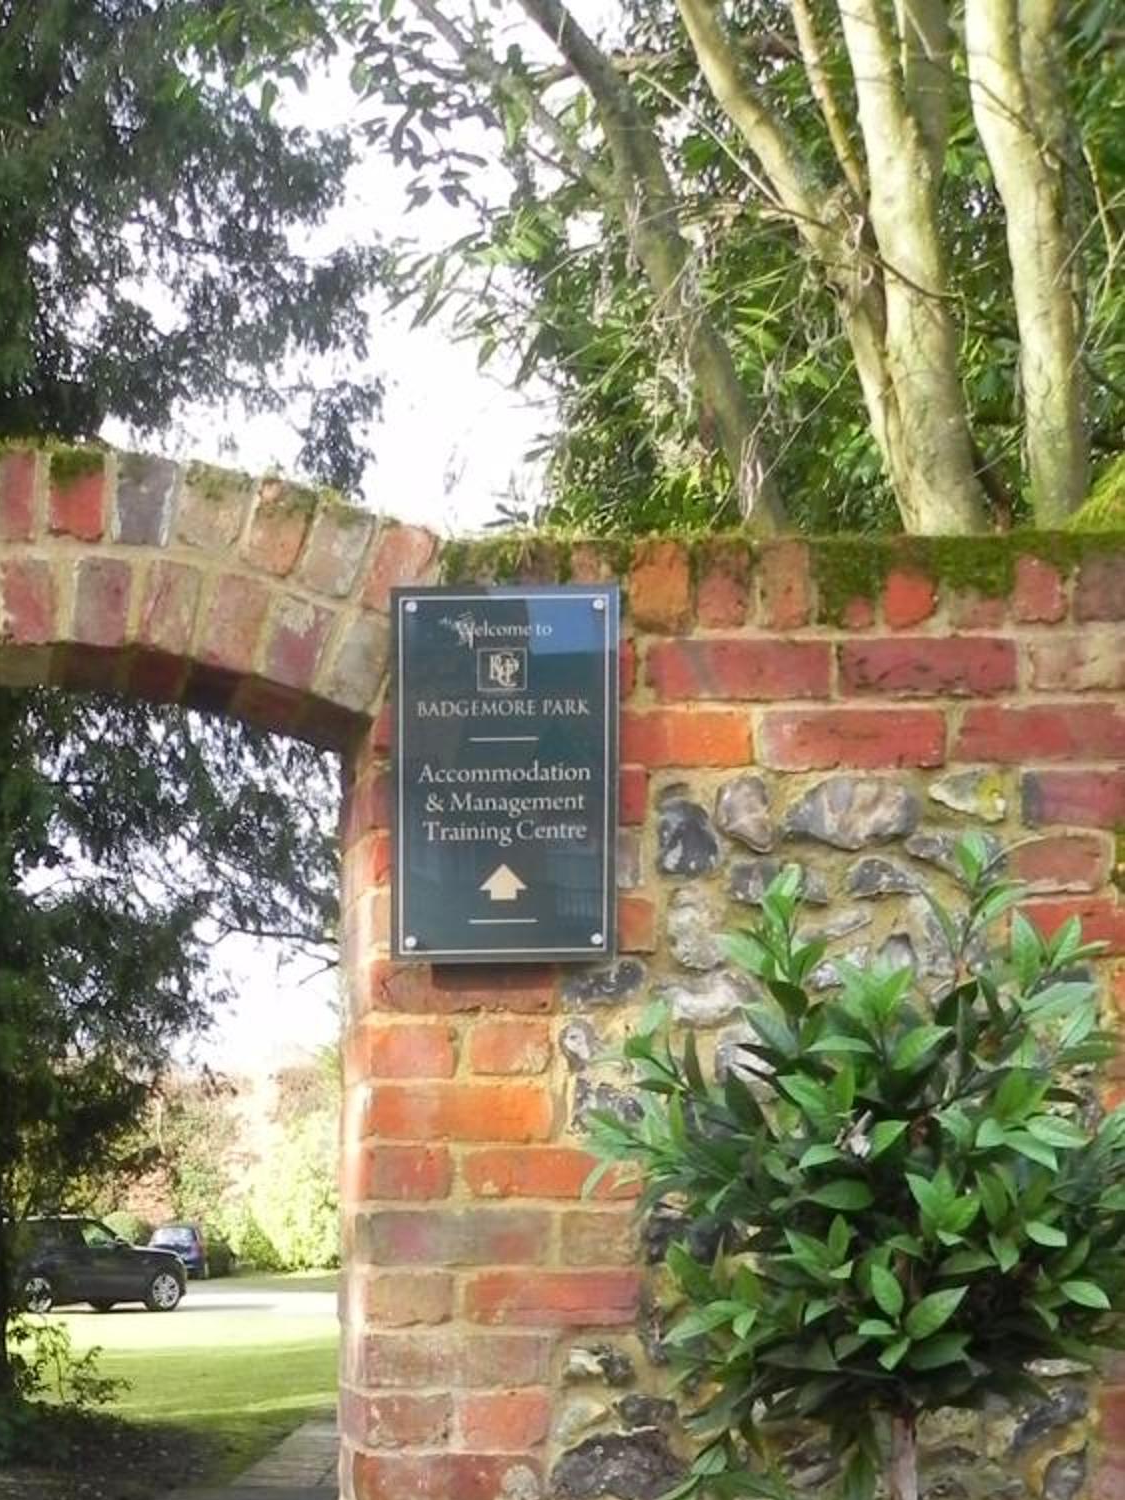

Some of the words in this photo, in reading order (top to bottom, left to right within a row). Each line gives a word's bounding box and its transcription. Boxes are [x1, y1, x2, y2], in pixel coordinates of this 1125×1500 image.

[455, 619, 531, 638] Welcome
[536, 623, 553, 637] to
[417, 699, 536, 717] BADGEMORE
[542, 698, 590, 716] PARK
[418, 760, 591, 784] Accommodation
[426, 792, 443, 812] &
[450, 791, 586, 819] Management
[422, 820, 513, 847] Training
[516, 819, 587, 840] Centre
